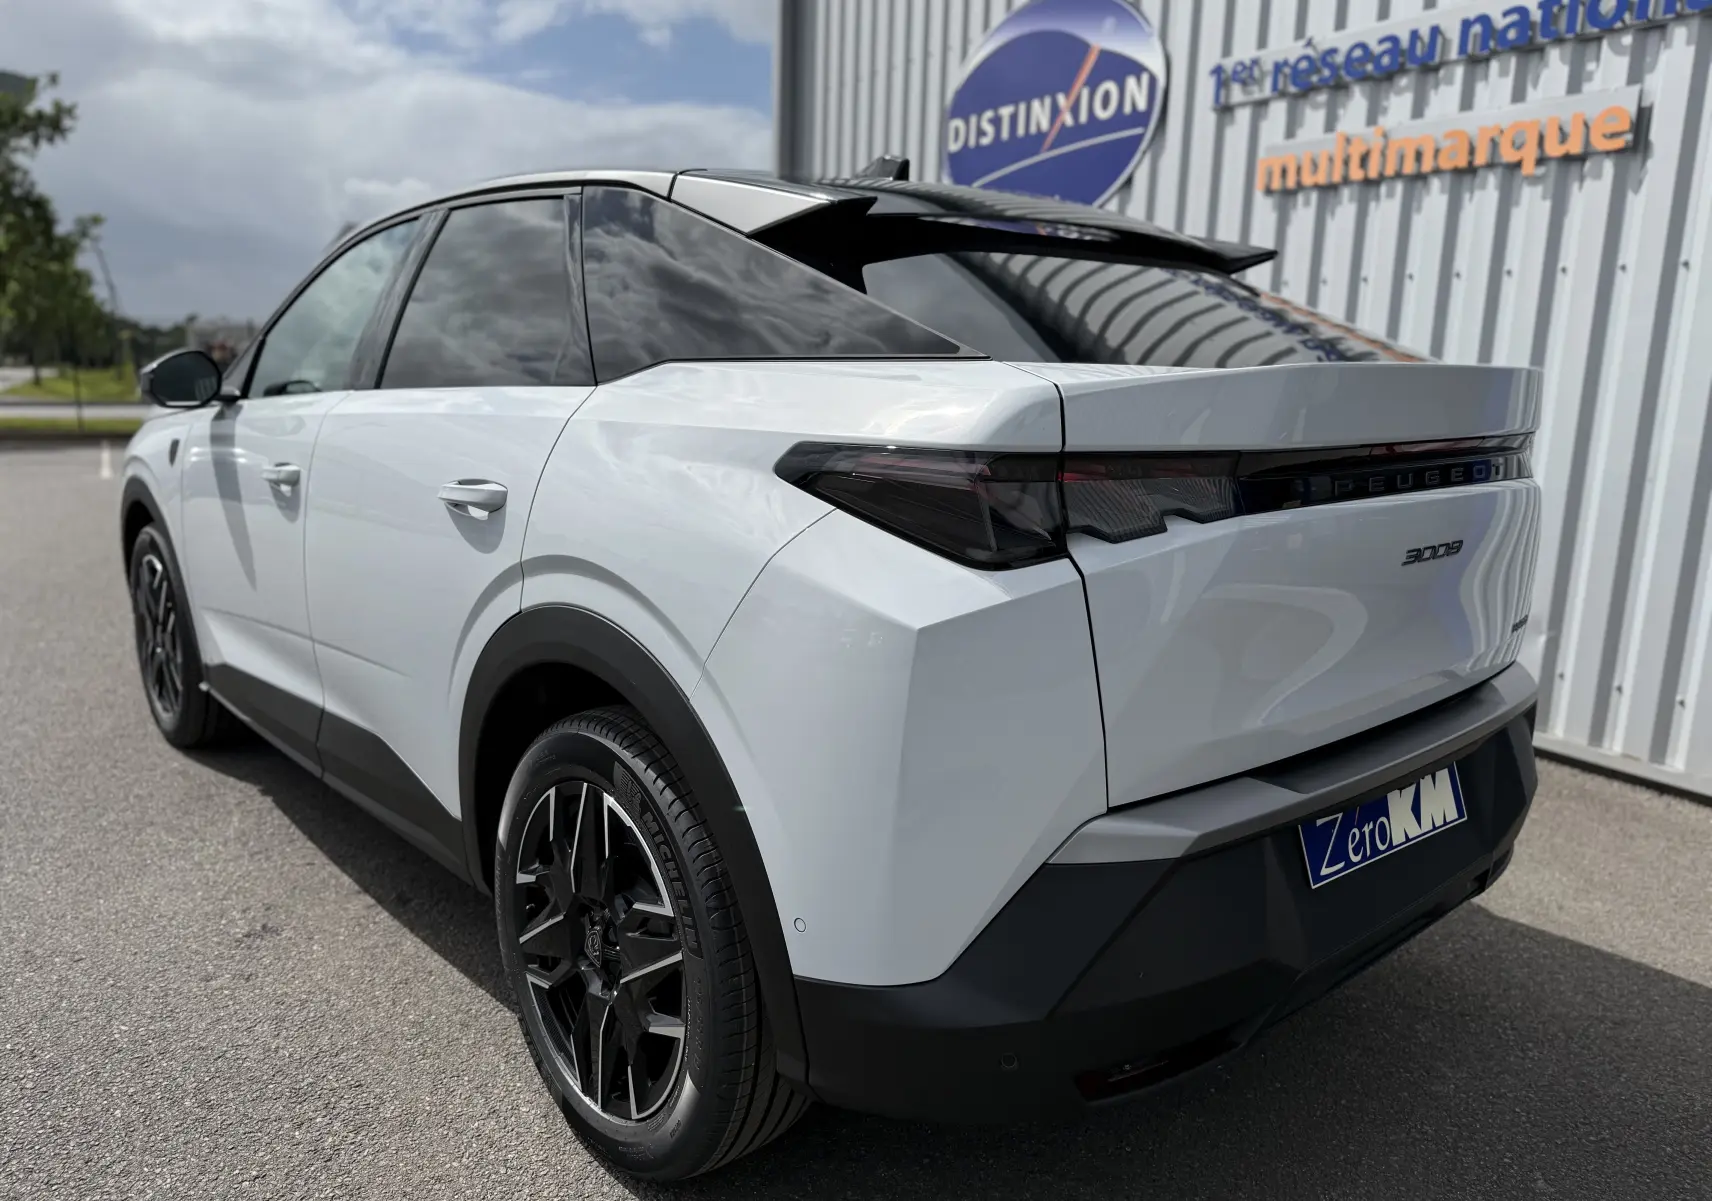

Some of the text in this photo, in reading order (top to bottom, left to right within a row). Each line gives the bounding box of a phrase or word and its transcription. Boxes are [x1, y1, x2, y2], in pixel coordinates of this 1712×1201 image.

[1271, 36, 1442, 95] réseau
[948, 71, 1150, 154] DISTINXION
[1256, 105, 1632, 191] multimarque
[1334, 457, 1504, 497] PEUGEOT
[1401, 539, 1464, 567] 3008
[640, 811, 699, 949] MICHELIN
